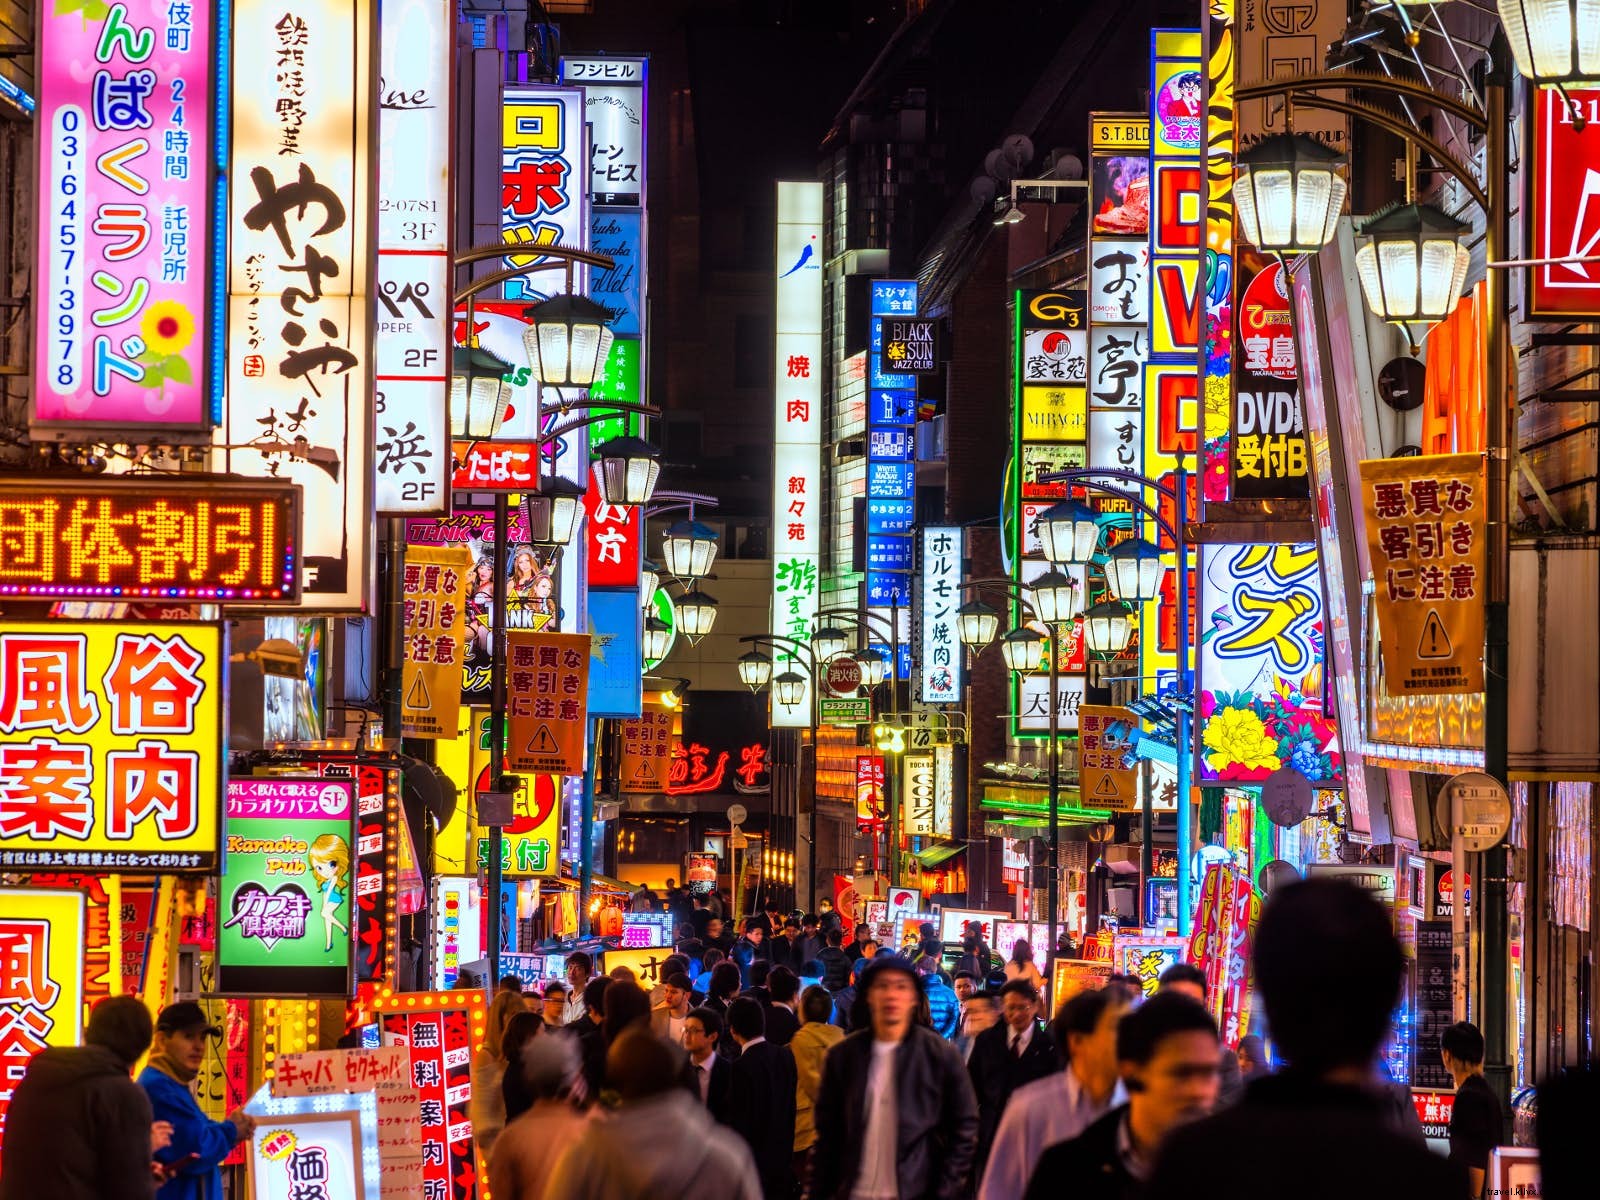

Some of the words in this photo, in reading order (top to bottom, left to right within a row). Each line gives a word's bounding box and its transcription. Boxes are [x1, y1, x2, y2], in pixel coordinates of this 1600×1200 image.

[572, 63, 635, 78] フジビル
[164, 79, 189, 180] 24時間
[1165, 124, 1201, 140] 金太
[592, 164, 638, 182] ービス
[93, 2, 156, 396] んぱくランド
[401, 222, 438, 241] 3F
[57, 109, 79, 386] 03-6457-3978
[163, 205, 188, 282] 託児所
[875, 287, 907, 298] えびす
[890, 300, 913, 311] 会館
[377, 322, 413, 333] PEPE
[892, 323, 934, 341] BLACK
[404, 349, 438, 368] 2F
[906, 341, 933, 360] SUN
[1245, 335, 1295, 370] 宝島
[892, 360, 913, 369] JAZZ
[914, 360, 934, 369] CLUB
[786, 354, 810, 423] 焼肉
[468, 450, 532, 482] たばこ
[401, 483, 436, 502] 2F
[1374, 478, 1474, 519] 悪質な
[787, 476, 806, 541] 叙々苑
[1099, 498, 1134, 513] HUFFL
[0, 499, 275, 585] 団体割引
[410, 524, 471, 543] TANK
[1379, 520, 1475, 562] 客引き
[403, 564, 457, 594] 悪質な
[1385, 563, 1476, 602] に注意
[932, 533, 954, 666] ホルモン焼肉
[513, 646, 582, 669] 悪質な
[512, 671, 581, 695] 客引き
[829, 668, 860, 682] 消火栓
[511, 696, 581, 721] に注意
[1023, 690, 1083, 718] 天照
[625, 728, 668, 743] 客引き
[624, 744, 668, 758] に注意
[0, 737, 199, 840] 案内
[227, 798, 319, 815] カラオケパブ
[322, 791, 344, 808] 5F
[359, 797, 382, 814] 安心
[226, 836, 308, 855] Karaoke
[265, 857, 306, 876] Pub
[446, 1050, 469, 1066] 安心
[278, 1059, 334, 1087] キャバ
[411, 1021, 449, 1200] 無料案内所
